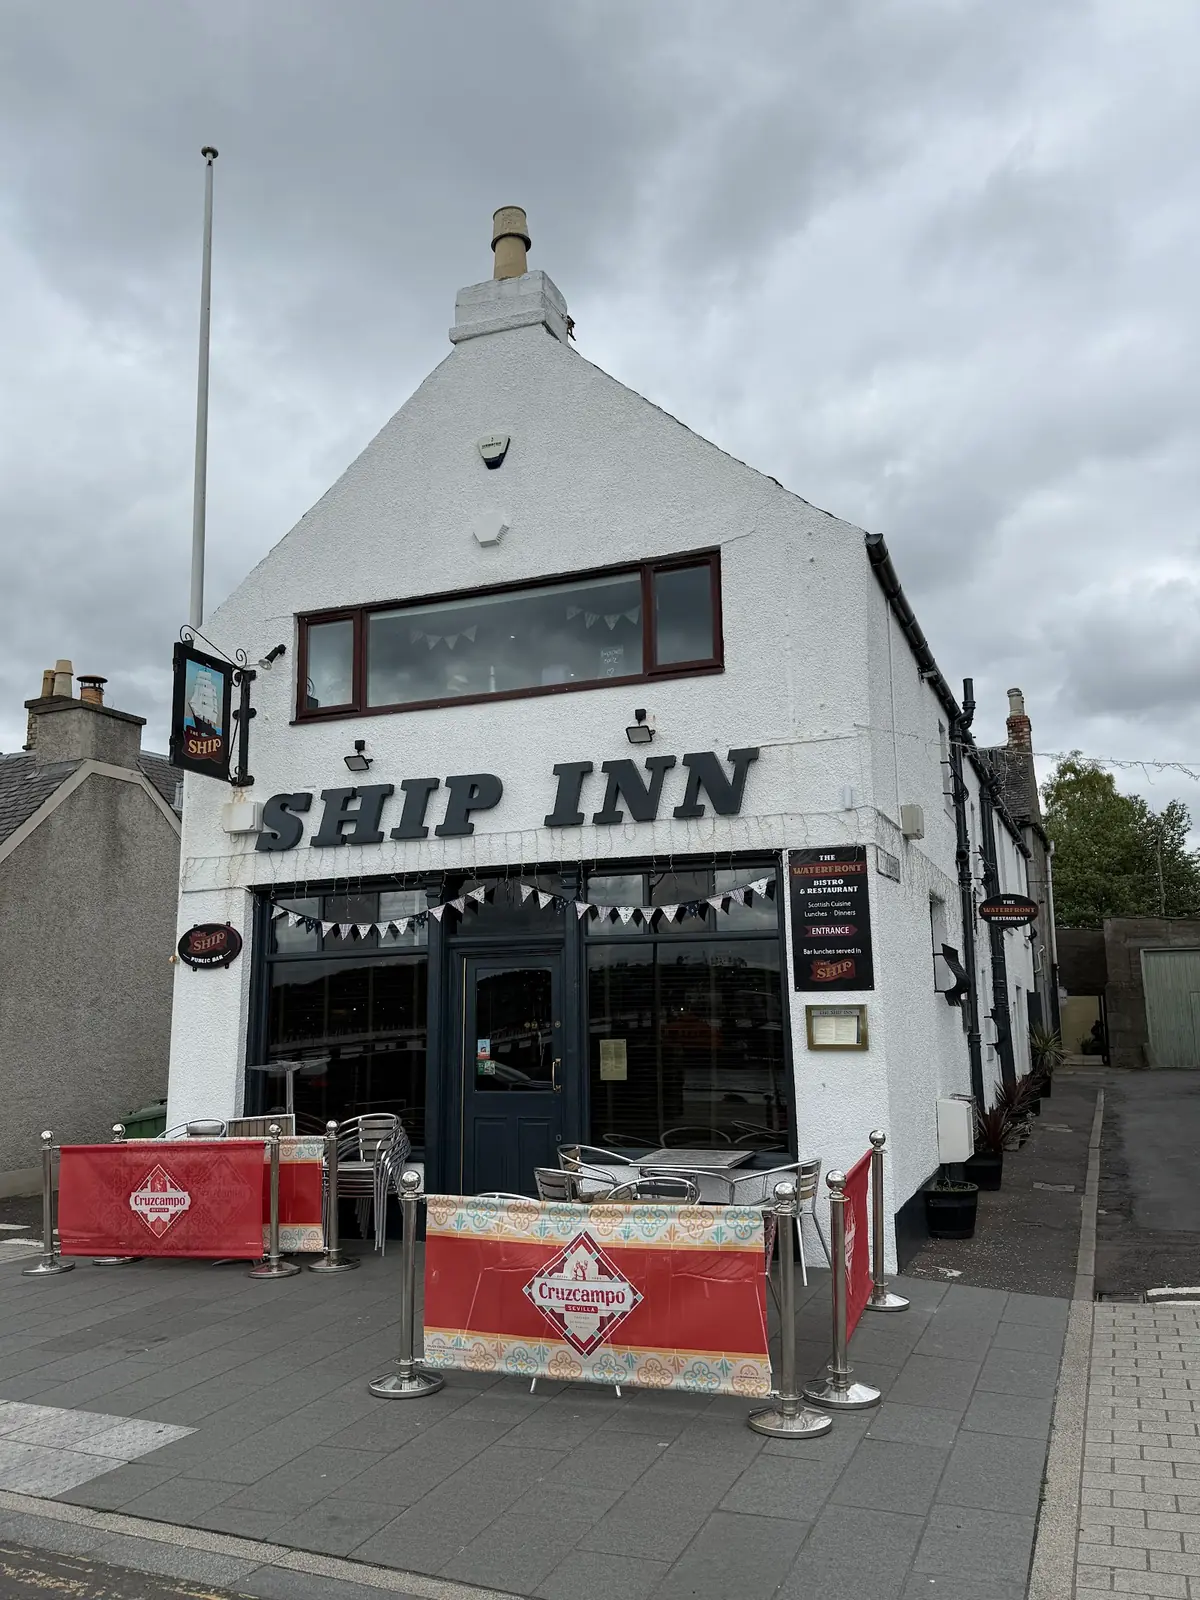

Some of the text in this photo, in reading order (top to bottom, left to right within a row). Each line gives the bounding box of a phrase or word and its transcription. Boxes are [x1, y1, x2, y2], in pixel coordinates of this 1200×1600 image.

[188, 738, 222, 754] SHIP
[254, 746, 760, 852] SHIP INN
[792, 864, 862, 875] WATERFRONT
[813, 878, 844, 886] BISTRO
[807, 885, 859, 894] RESTAURANT
[811, 926, 850, 935] ENTRANCE
[193, 932, 226, 951] SHIP
[190, 954, 224, 964] PUBLIC BAR
[816, 960, 852, 979] SHIP
[134, 1194, 186, 1207] Cruzcampo
[538, 1282, 626, 1307] Cruzcampo
[567, 1305, 595, 1313] SEVILLA
